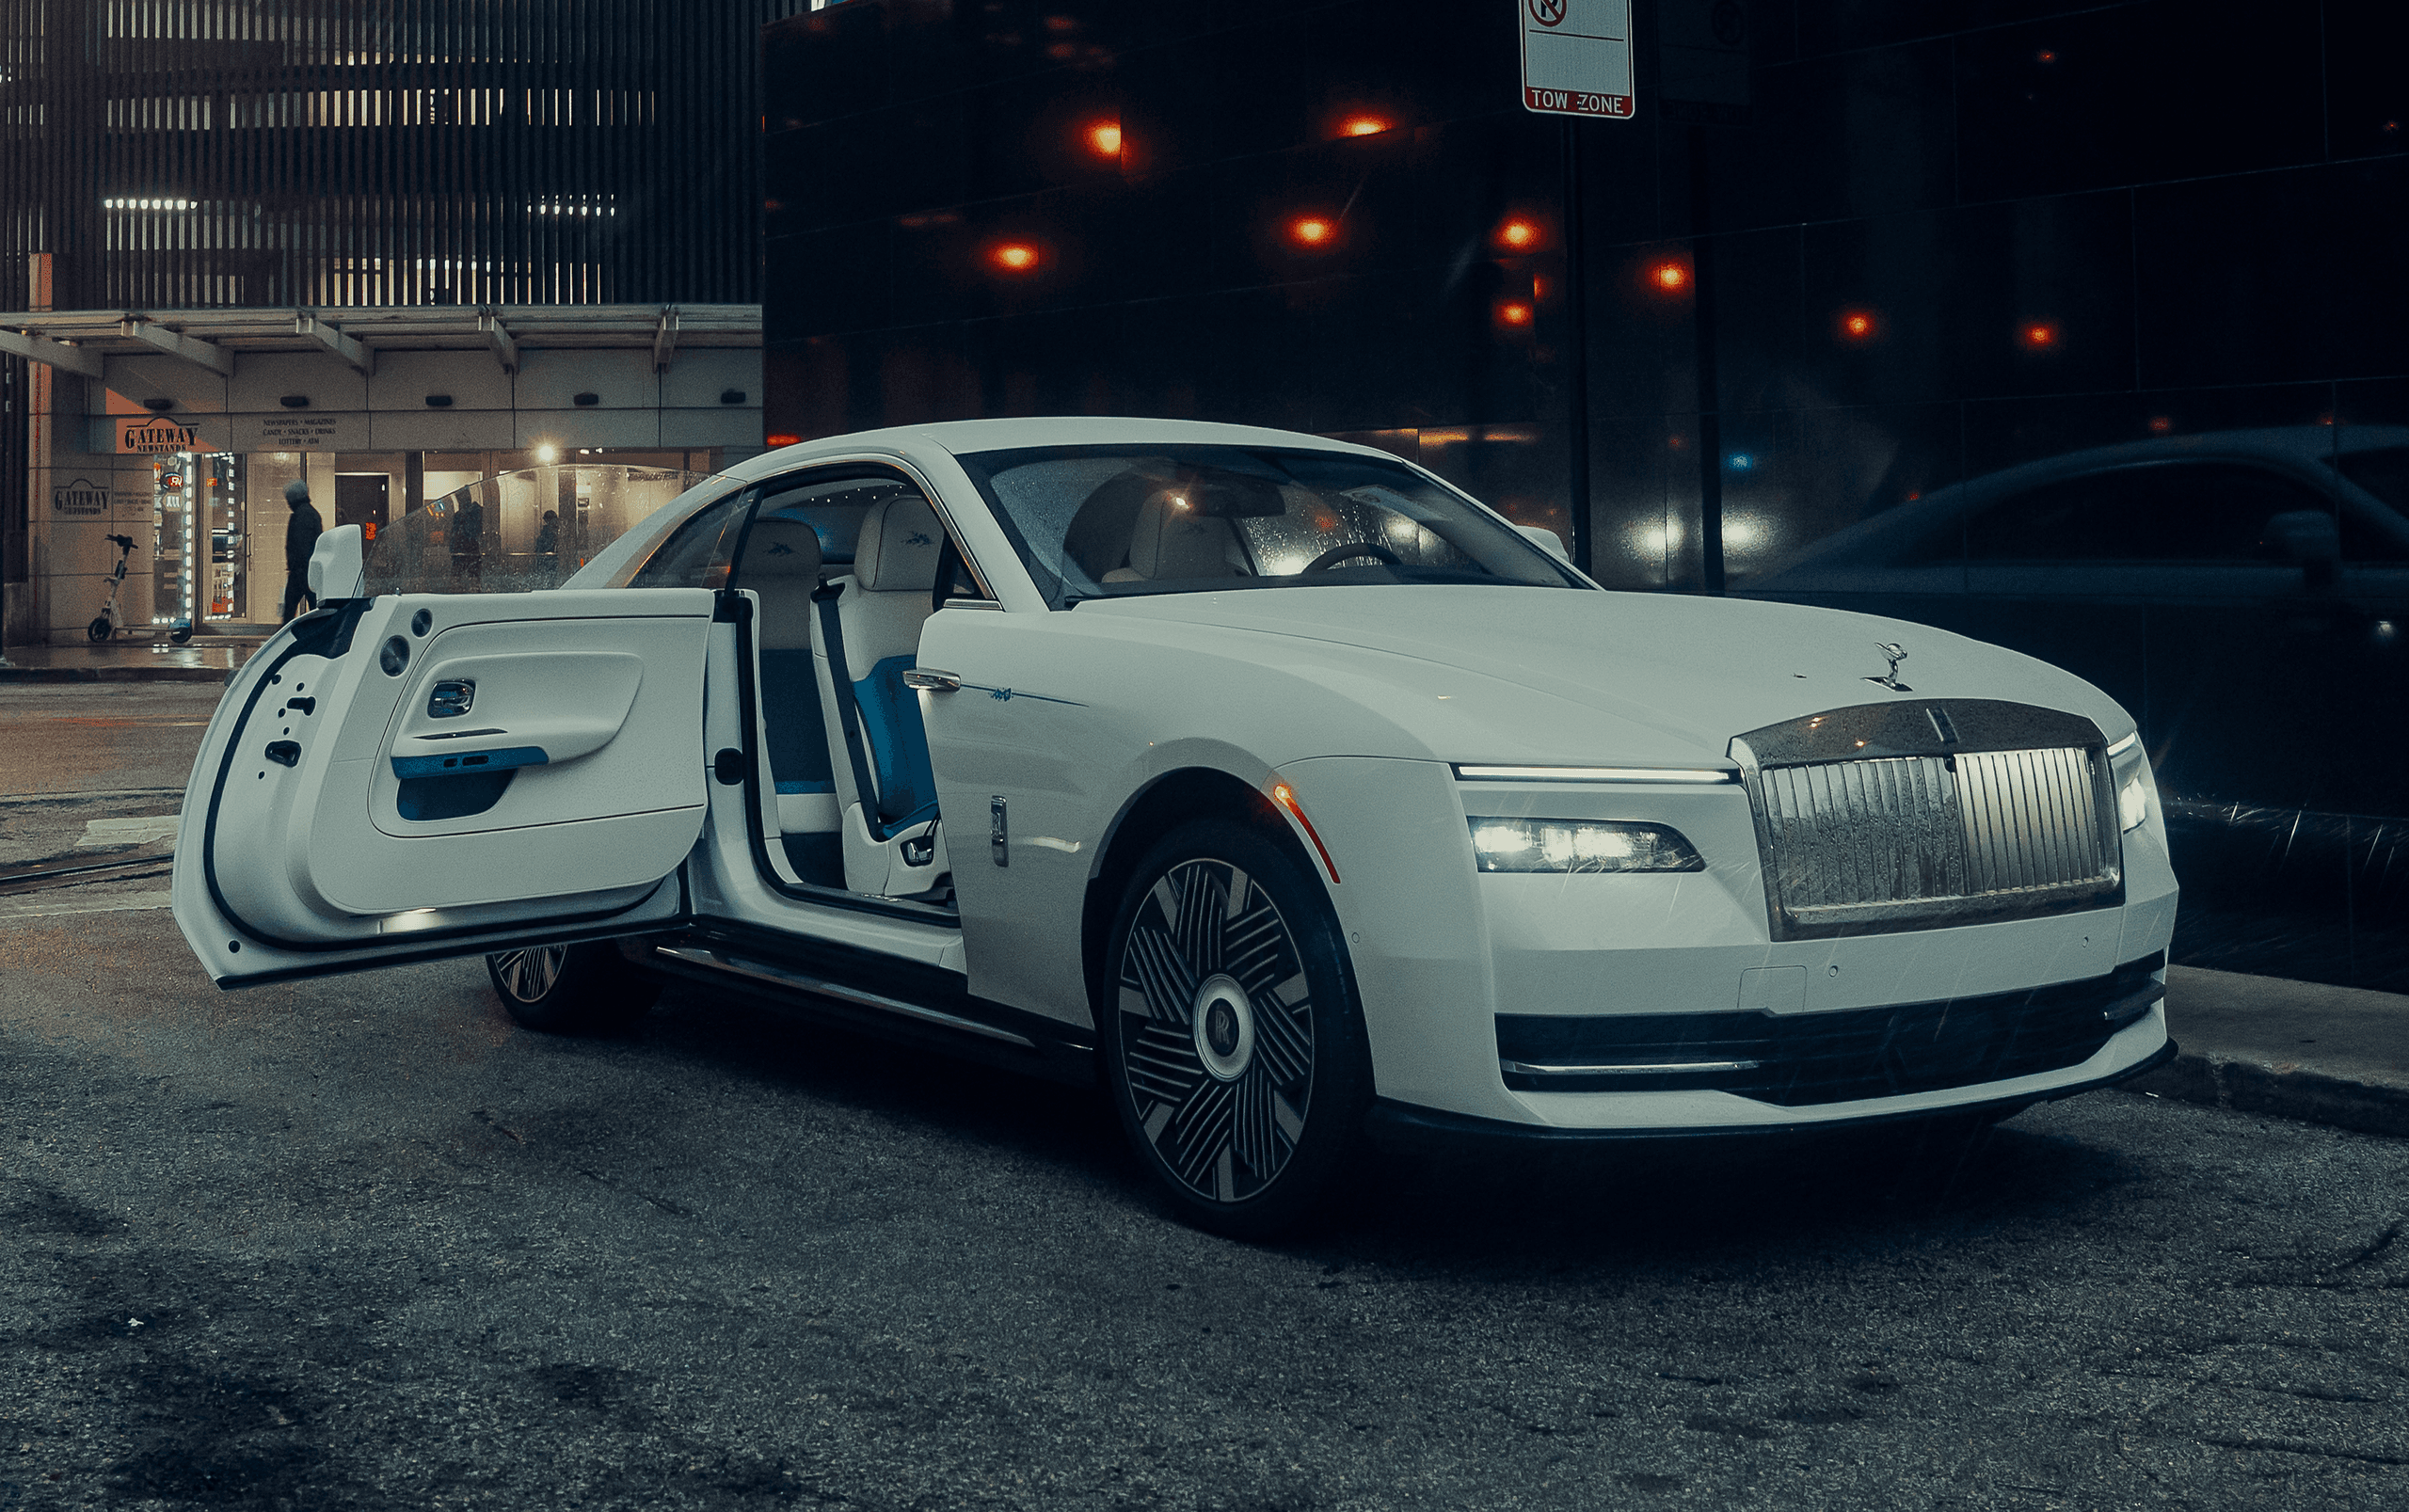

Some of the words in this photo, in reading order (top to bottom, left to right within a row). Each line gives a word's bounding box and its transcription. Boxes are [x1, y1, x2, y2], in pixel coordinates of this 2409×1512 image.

[1531, 89, 1568, 109] TOW
[1578, 94, 1624, 114] ZONE
[124, 427, 199, 449] GATEWAY
[136, 444, 186, 453] NEWSTANDS
[55, 490, 110, 511] GATEWAY
